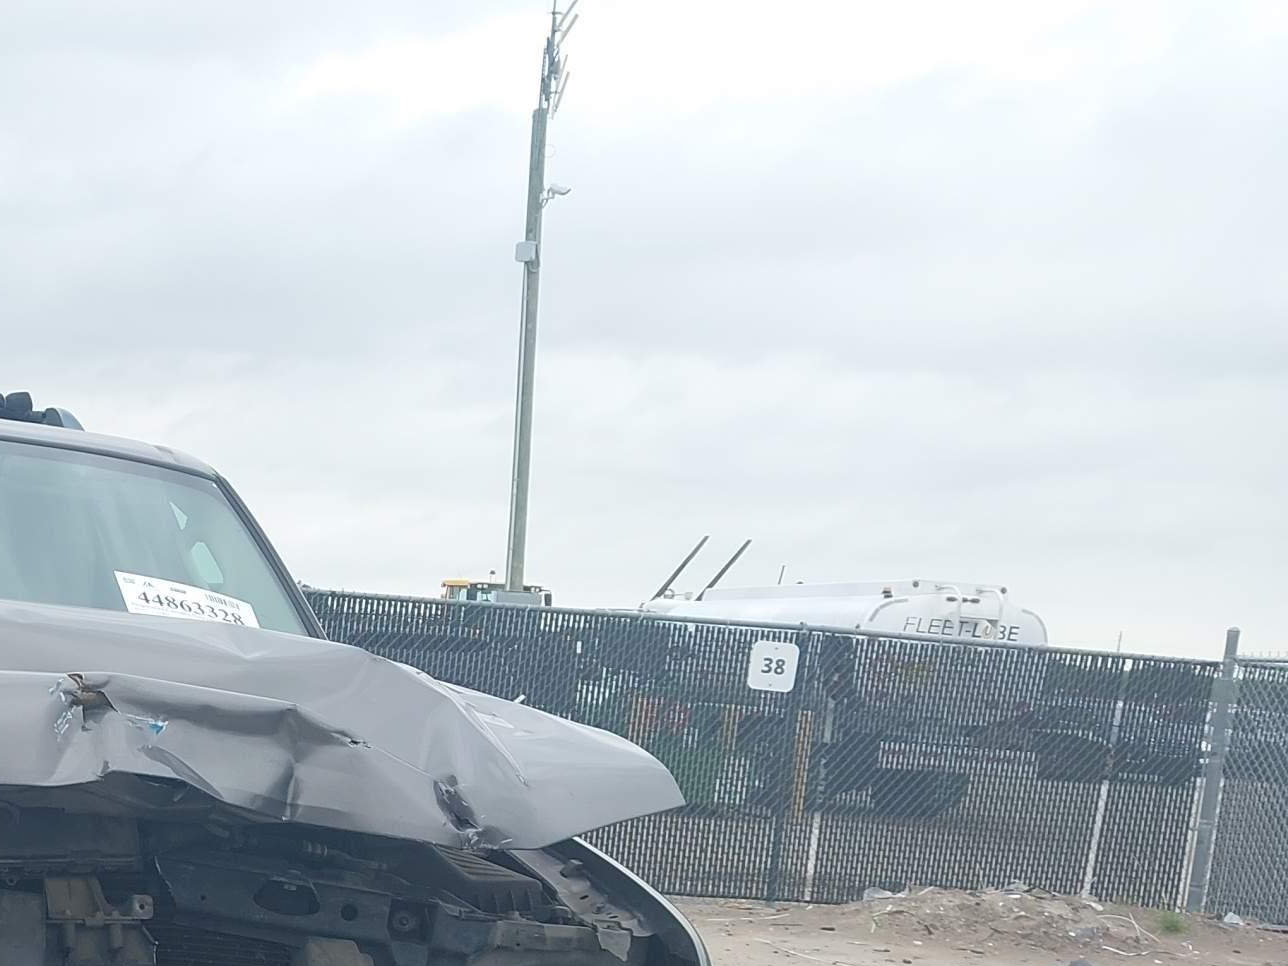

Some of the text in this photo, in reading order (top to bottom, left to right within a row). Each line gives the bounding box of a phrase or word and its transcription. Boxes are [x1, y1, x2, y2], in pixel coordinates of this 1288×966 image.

[138, 591, 245, 626] 44863328
[903, 616, 1020, 641] FLEET-LBE
[761, 657, 785, 675] 38
